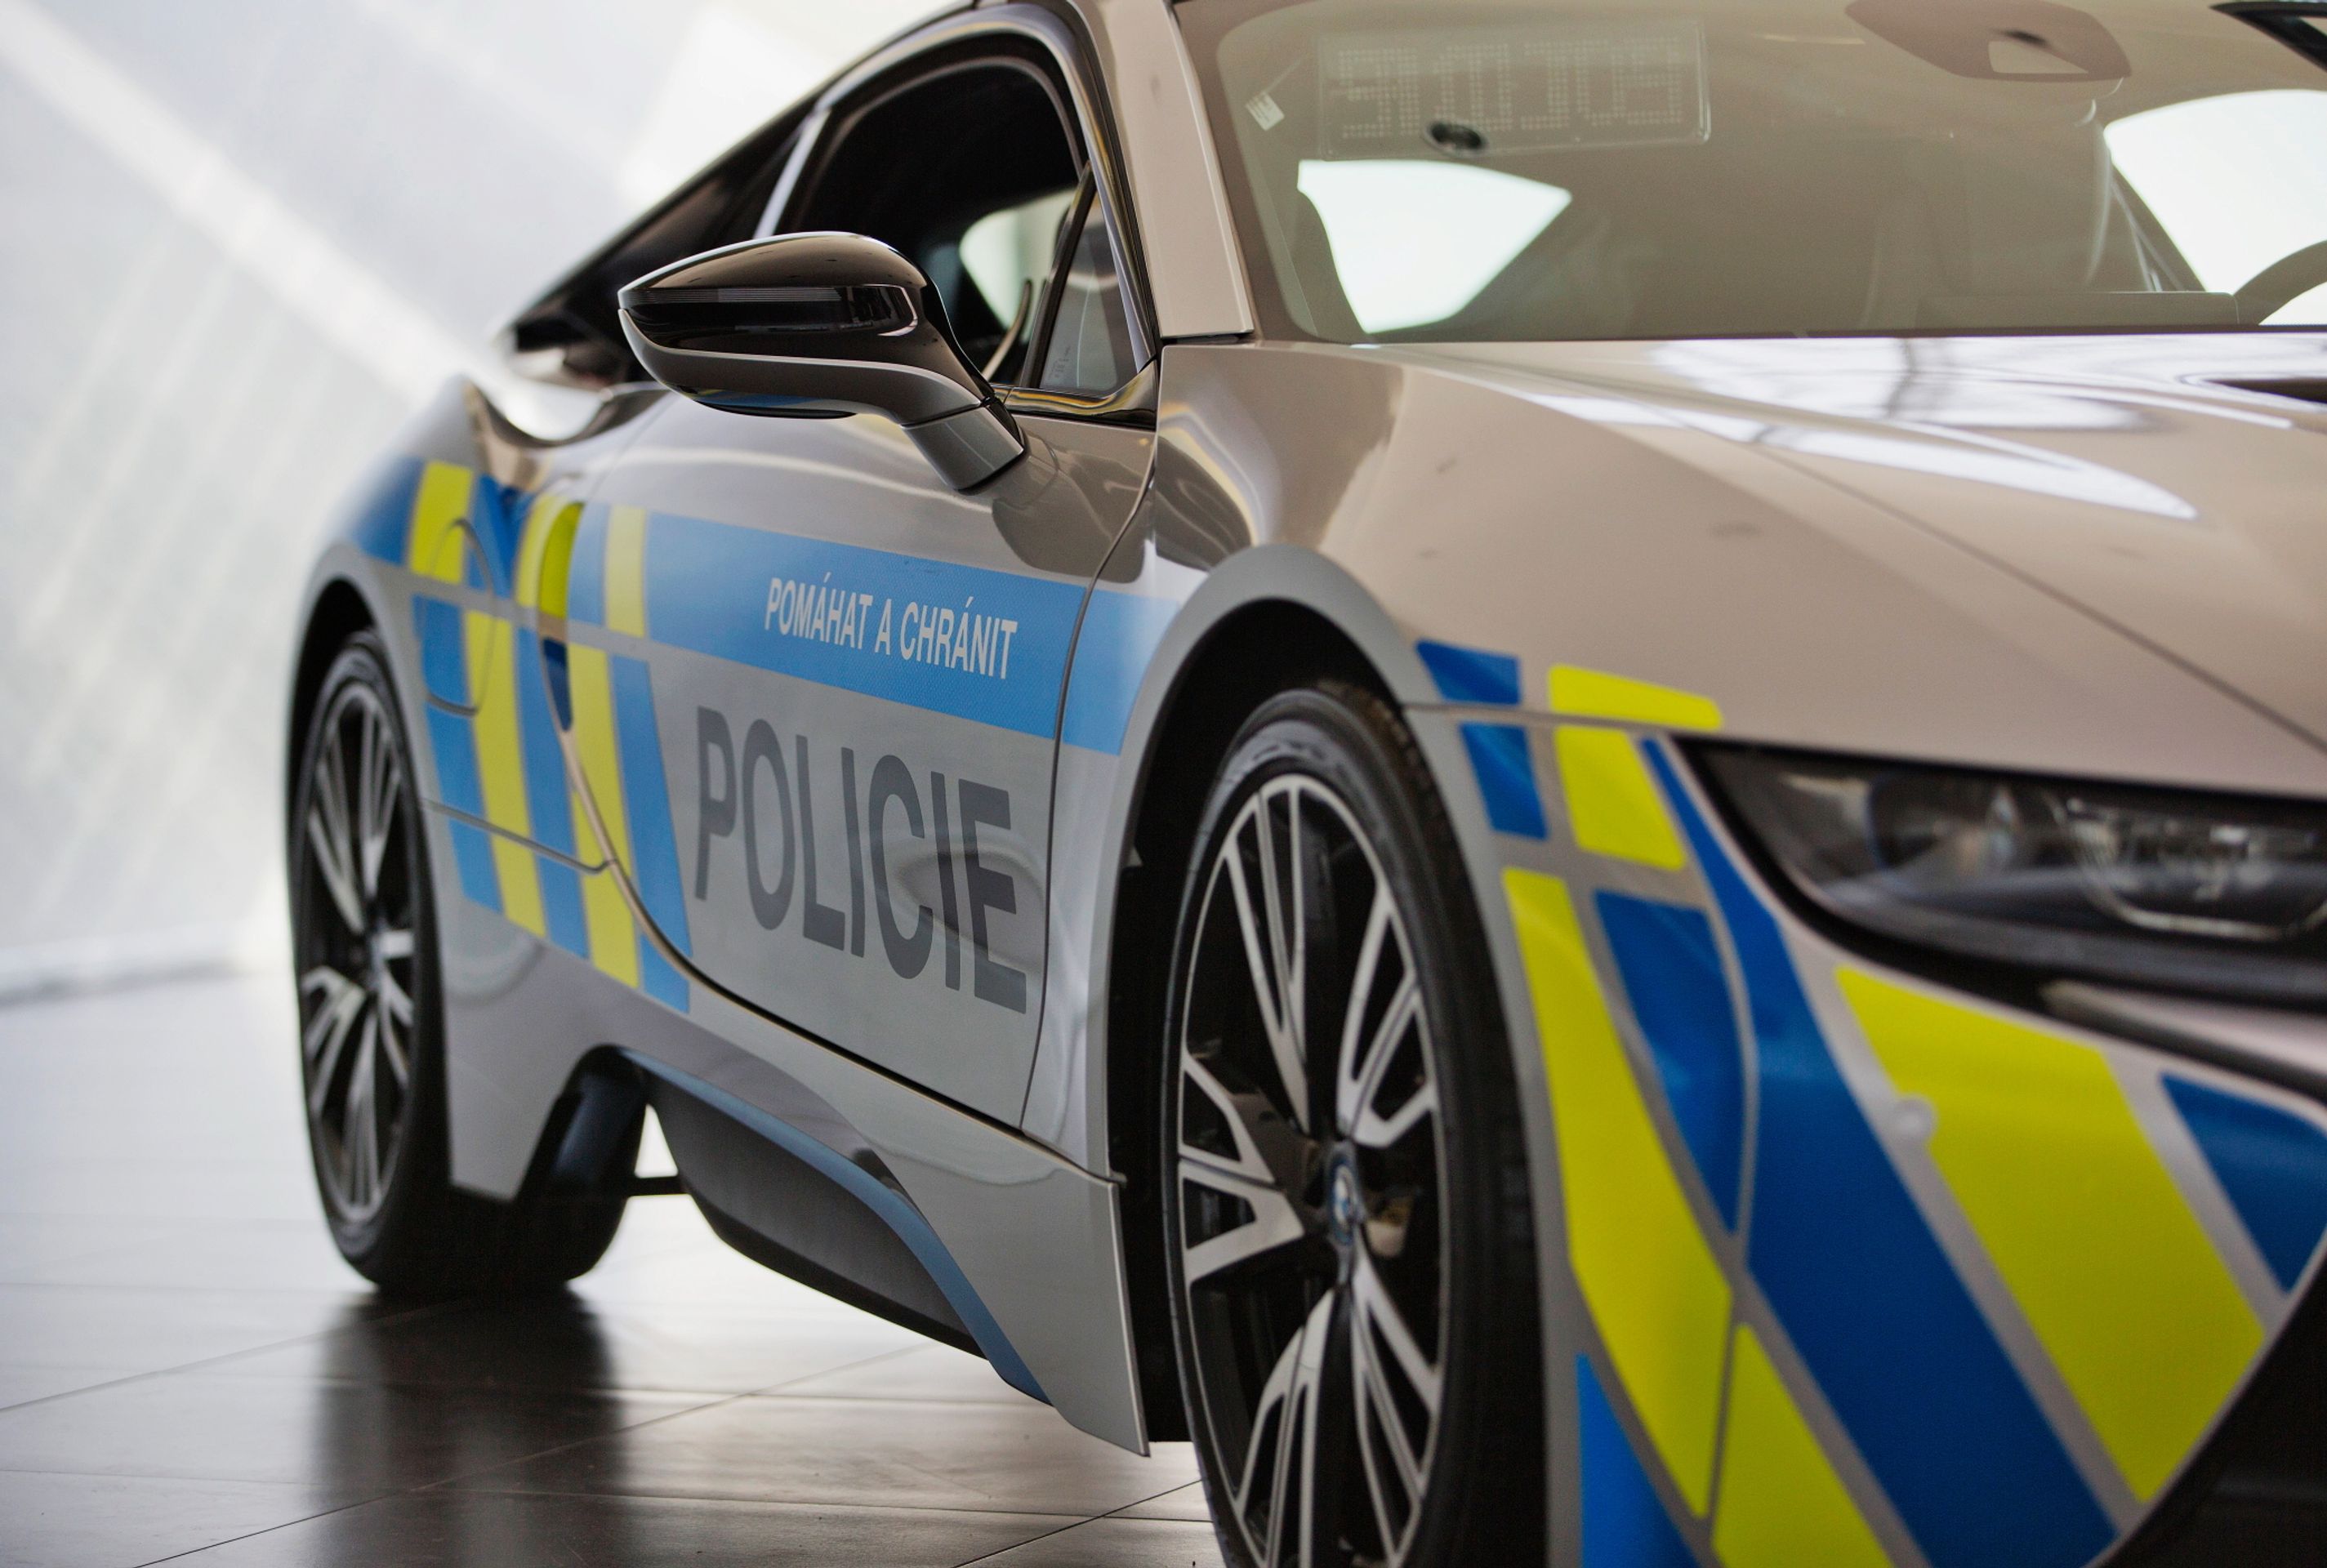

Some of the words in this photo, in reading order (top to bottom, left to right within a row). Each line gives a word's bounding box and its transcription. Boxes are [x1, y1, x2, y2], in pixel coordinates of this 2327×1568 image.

[765, 572, 873, 650] POMÁHAT
[876, 599, 893, 654] A
[900, 596, 1018, 679] CHRÁNIT
[695, 706, 1027, 1014] POLICIE
